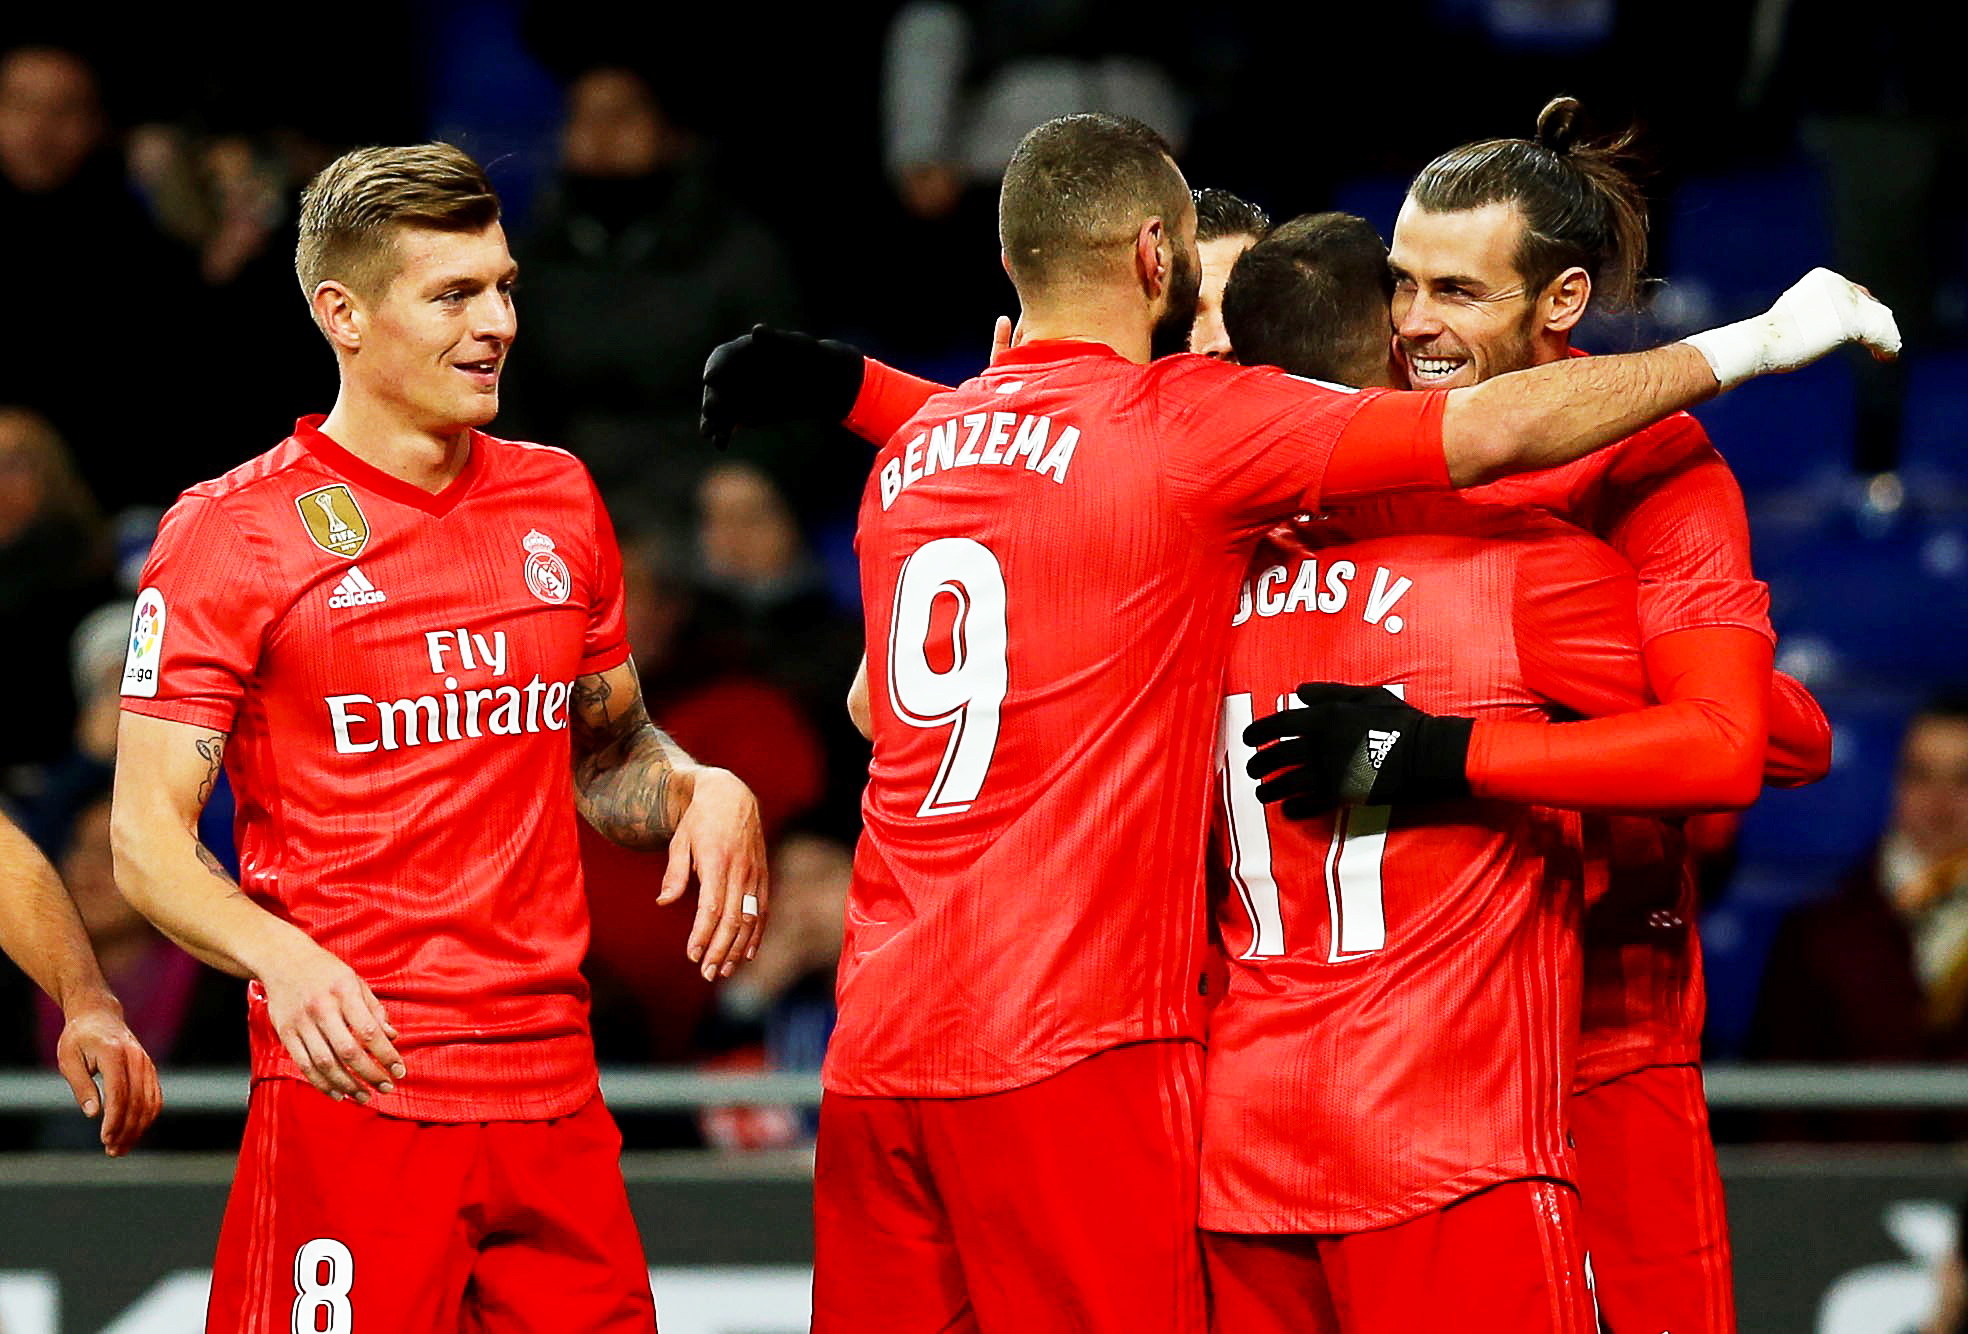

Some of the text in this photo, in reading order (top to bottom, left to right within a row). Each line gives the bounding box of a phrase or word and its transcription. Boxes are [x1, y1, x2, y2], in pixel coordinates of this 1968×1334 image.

[880, 411, 1081, 512] BENZEMA
[328, 588, 387, 608] adidas
[1363, 566, 1413, 634] V.
[425, 628, 506, 676] Fly
[888, 537, 1008, 818] 9
[290, 1238, 354, 1334] 8
